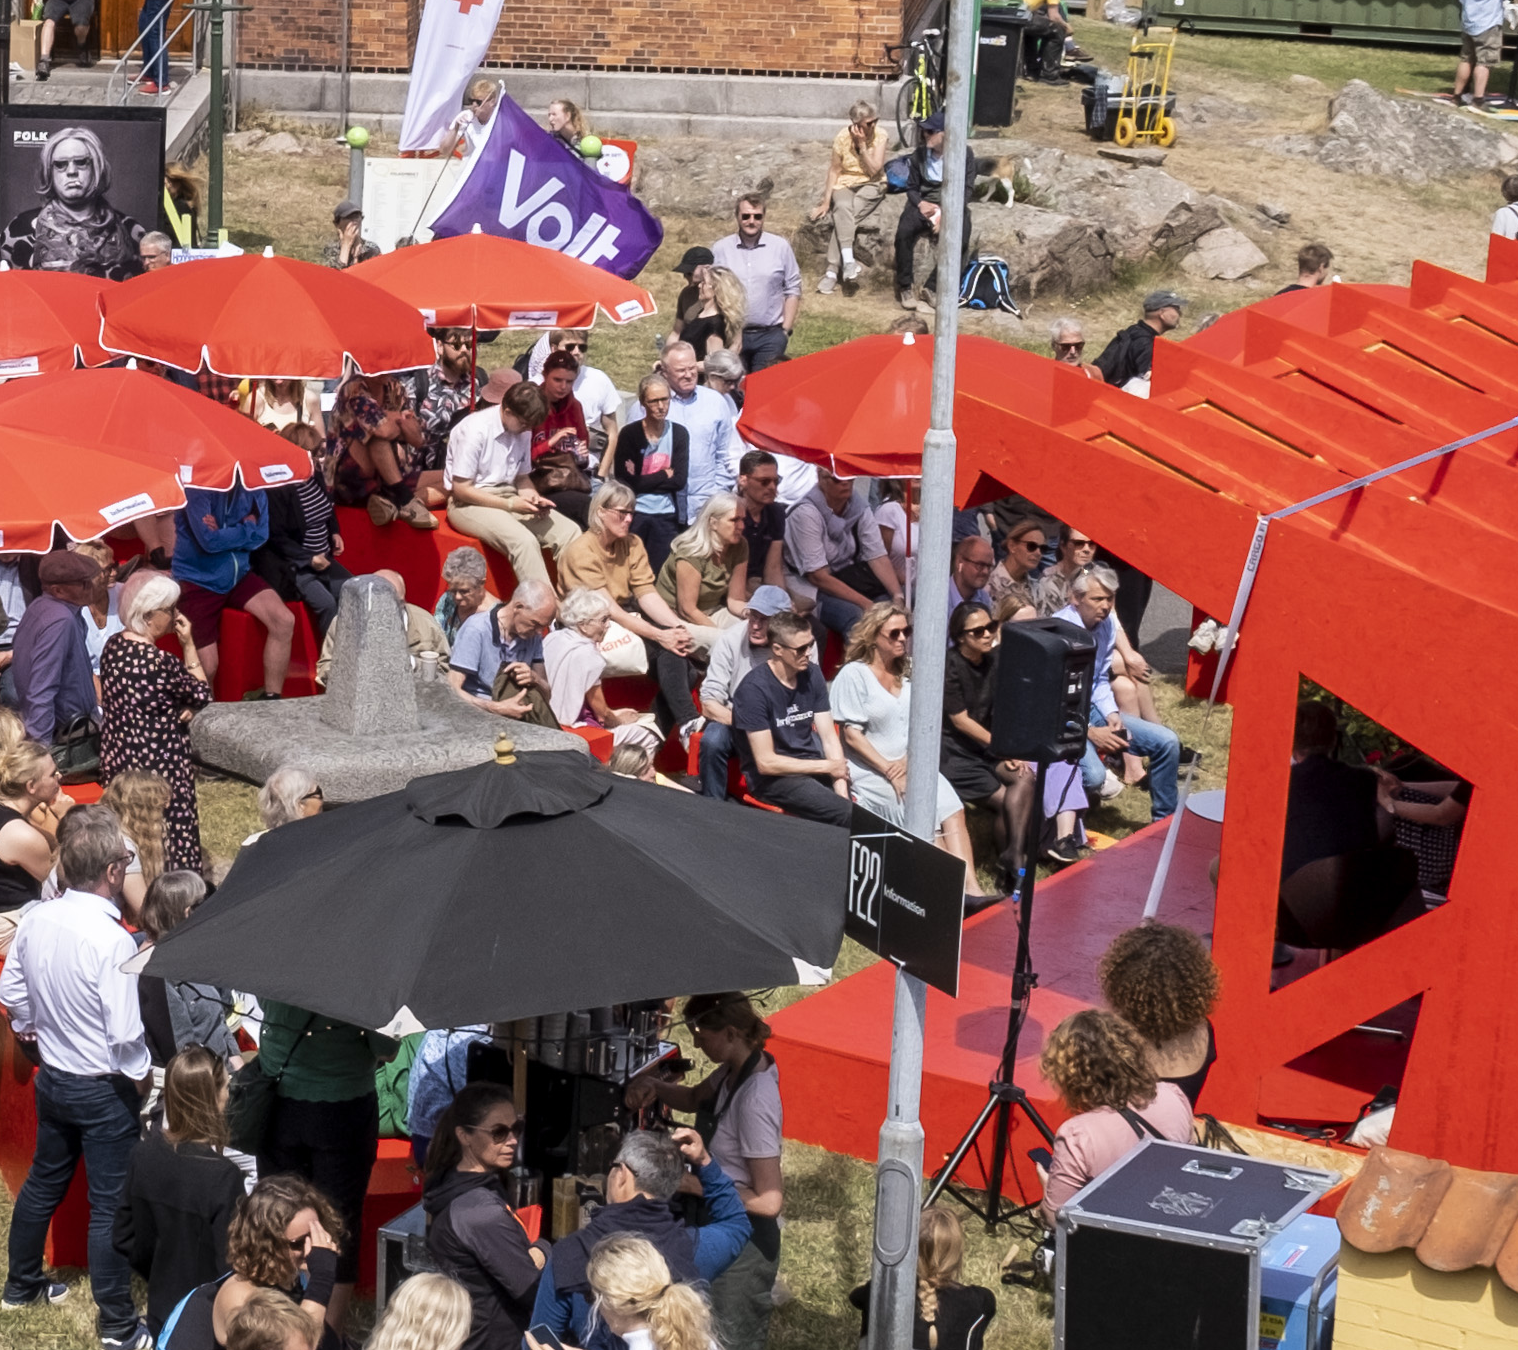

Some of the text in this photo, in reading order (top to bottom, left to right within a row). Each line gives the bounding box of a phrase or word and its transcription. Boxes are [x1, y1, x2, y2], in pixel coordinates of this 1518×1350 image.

[13, 130, 50, 142] FOLK
[497, 148, 621, 265] Volt
[849, 839, 881, 928] F22
[883, 884, 926, 918] Information
